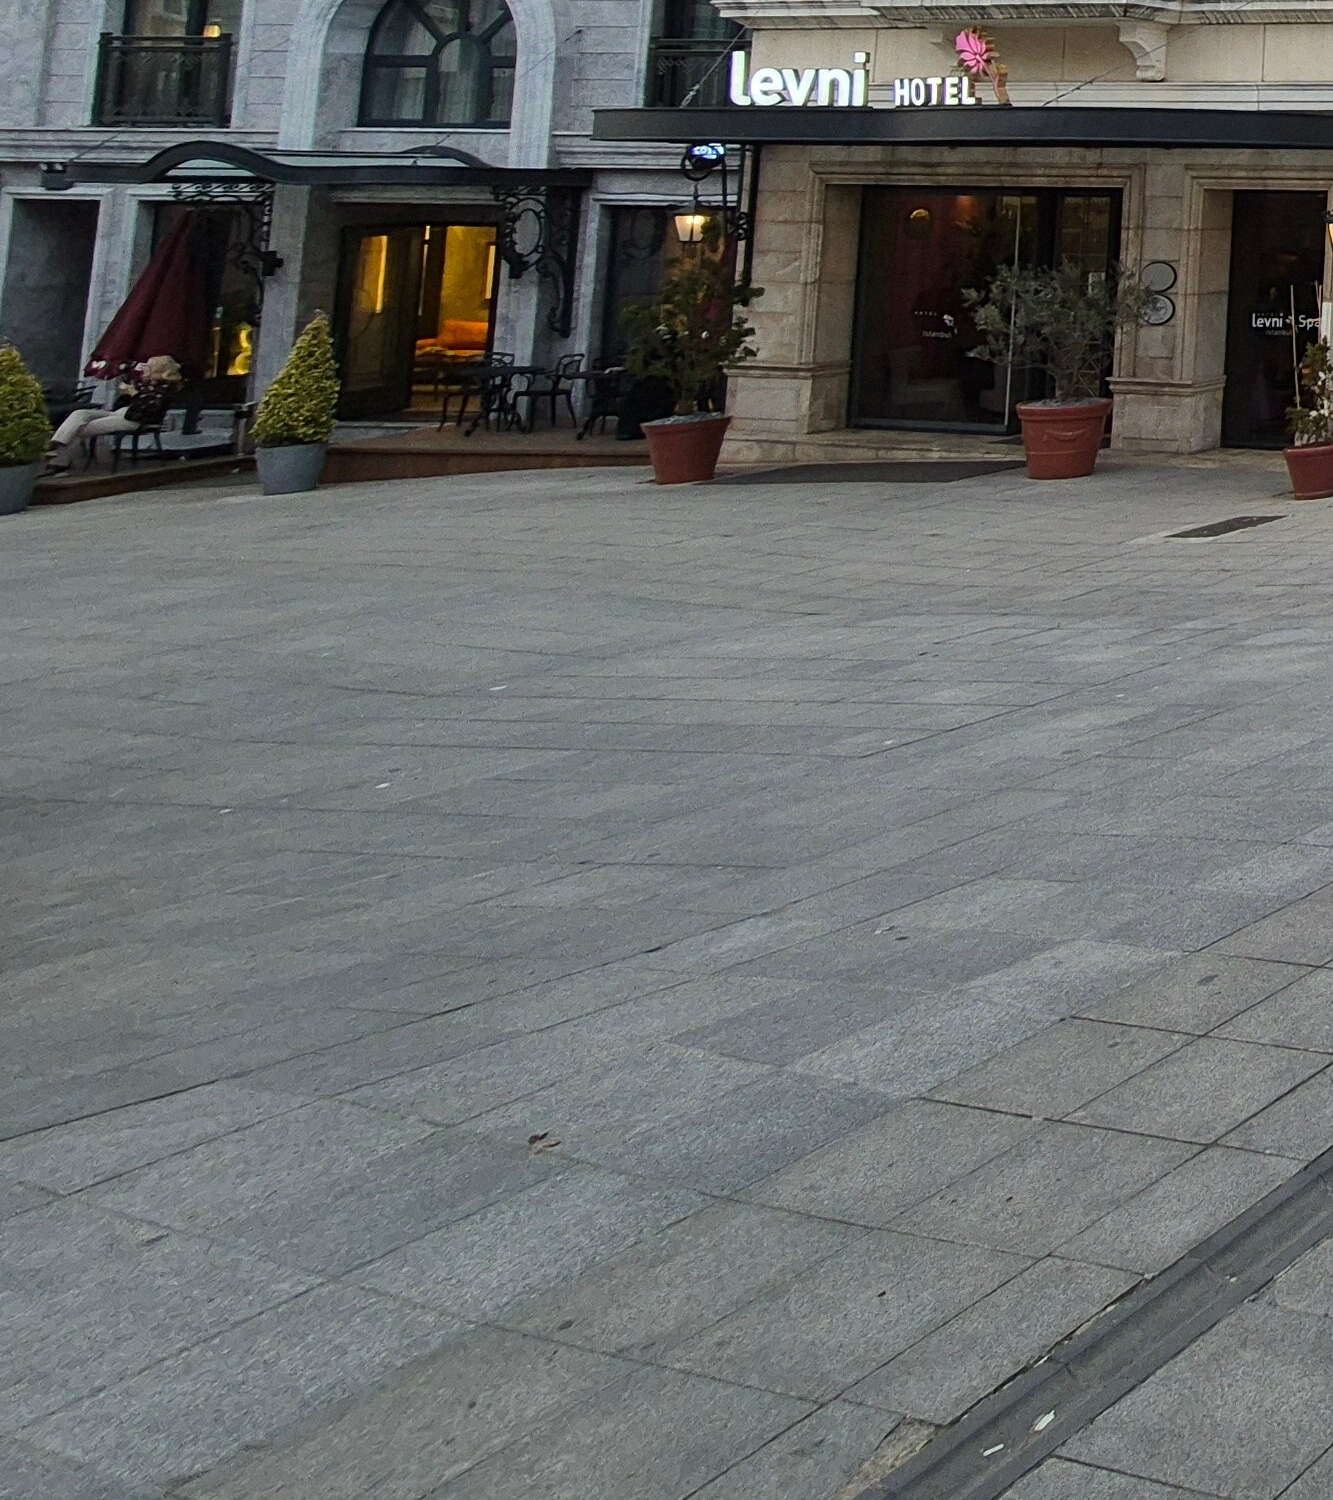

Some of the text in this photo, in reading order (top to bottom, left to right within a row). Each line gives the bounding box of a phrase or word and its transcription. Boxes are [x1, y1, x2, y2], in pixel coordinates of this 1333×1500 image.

[729, 50, 977, 107] levni HOTEL
[1252, 313, 1284, 328] levni
